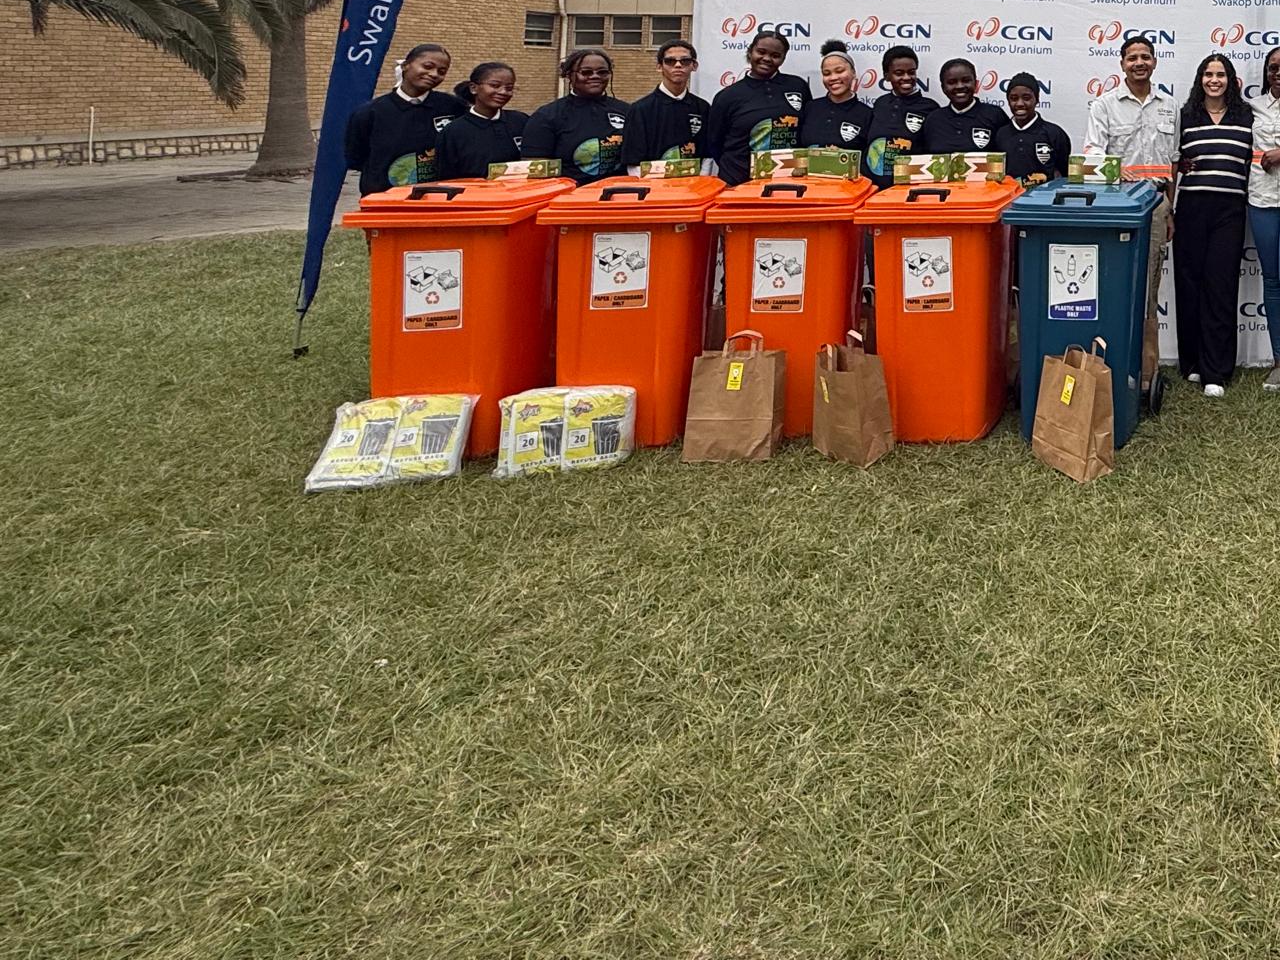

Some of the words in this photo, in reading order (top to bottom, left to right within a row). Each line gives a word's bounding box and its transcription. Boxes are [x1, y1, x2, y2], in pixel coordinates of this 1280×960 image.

[880, 23, 931, 39] CGN
[1001, 25, 1053, 41] CGN
[721, 41, 750, 51] Swak
[846, 42, 884, 54] Swakop
[966, 43, 1007, 56] Swakop
[1009, 45, 1052, 55] Uranium
[1088, 47, 1121, 57] Swako
[341, 433, 355, 443] 20
[402, 432, 414, 443] 20
[574, 434, 586, 444] 20
[522, 438, 535, 448] 20
[571, 456, 597, 464] REFUSE
